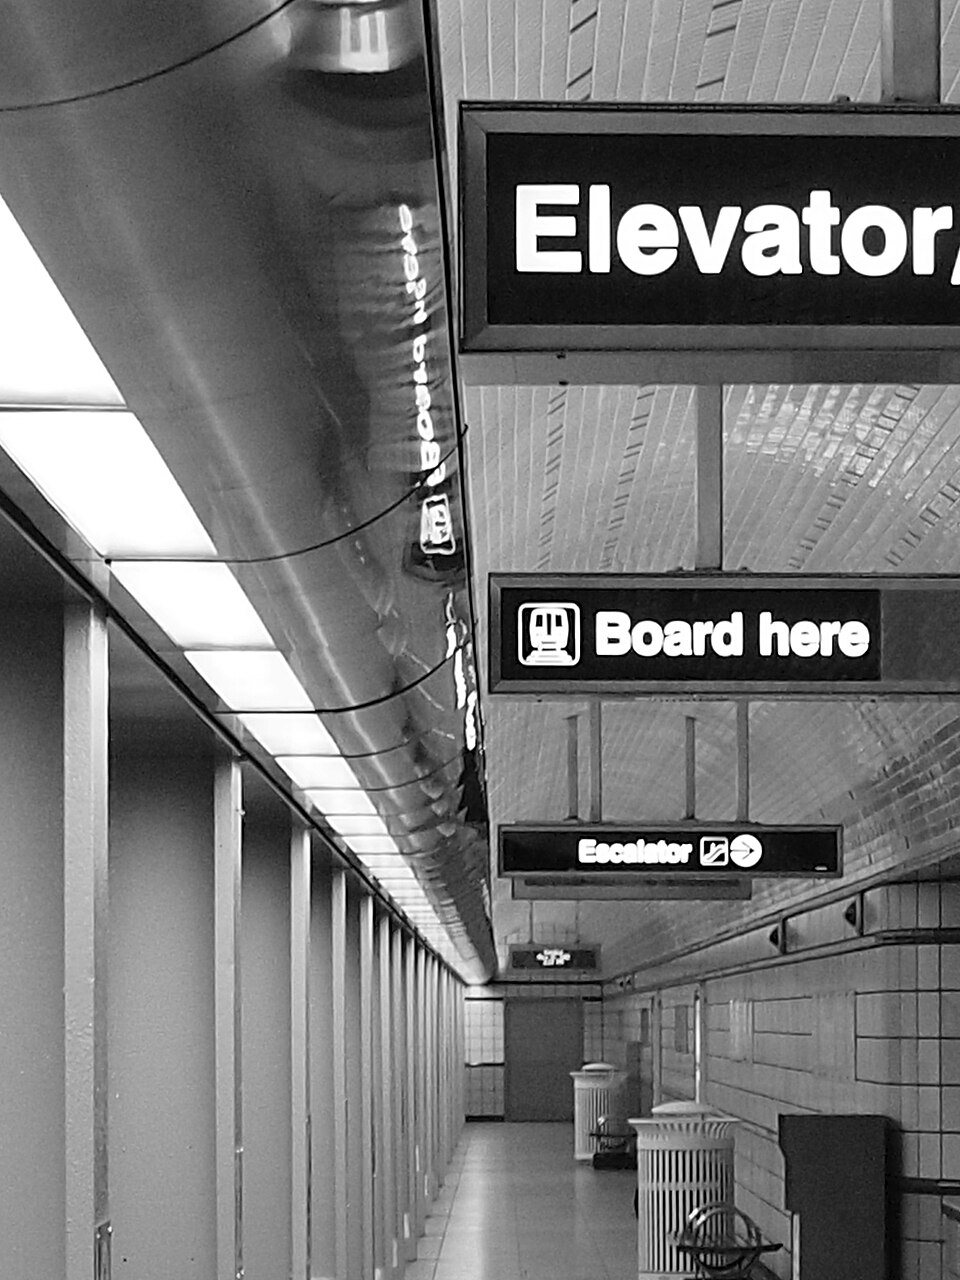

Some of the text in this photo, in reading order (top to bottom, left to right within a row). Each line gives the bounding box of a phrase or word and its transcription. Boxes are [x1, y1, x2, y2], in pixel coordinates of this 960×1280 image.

[595, 611, 871, 658] Board here
[578, 838, 693, 864] Escalator
